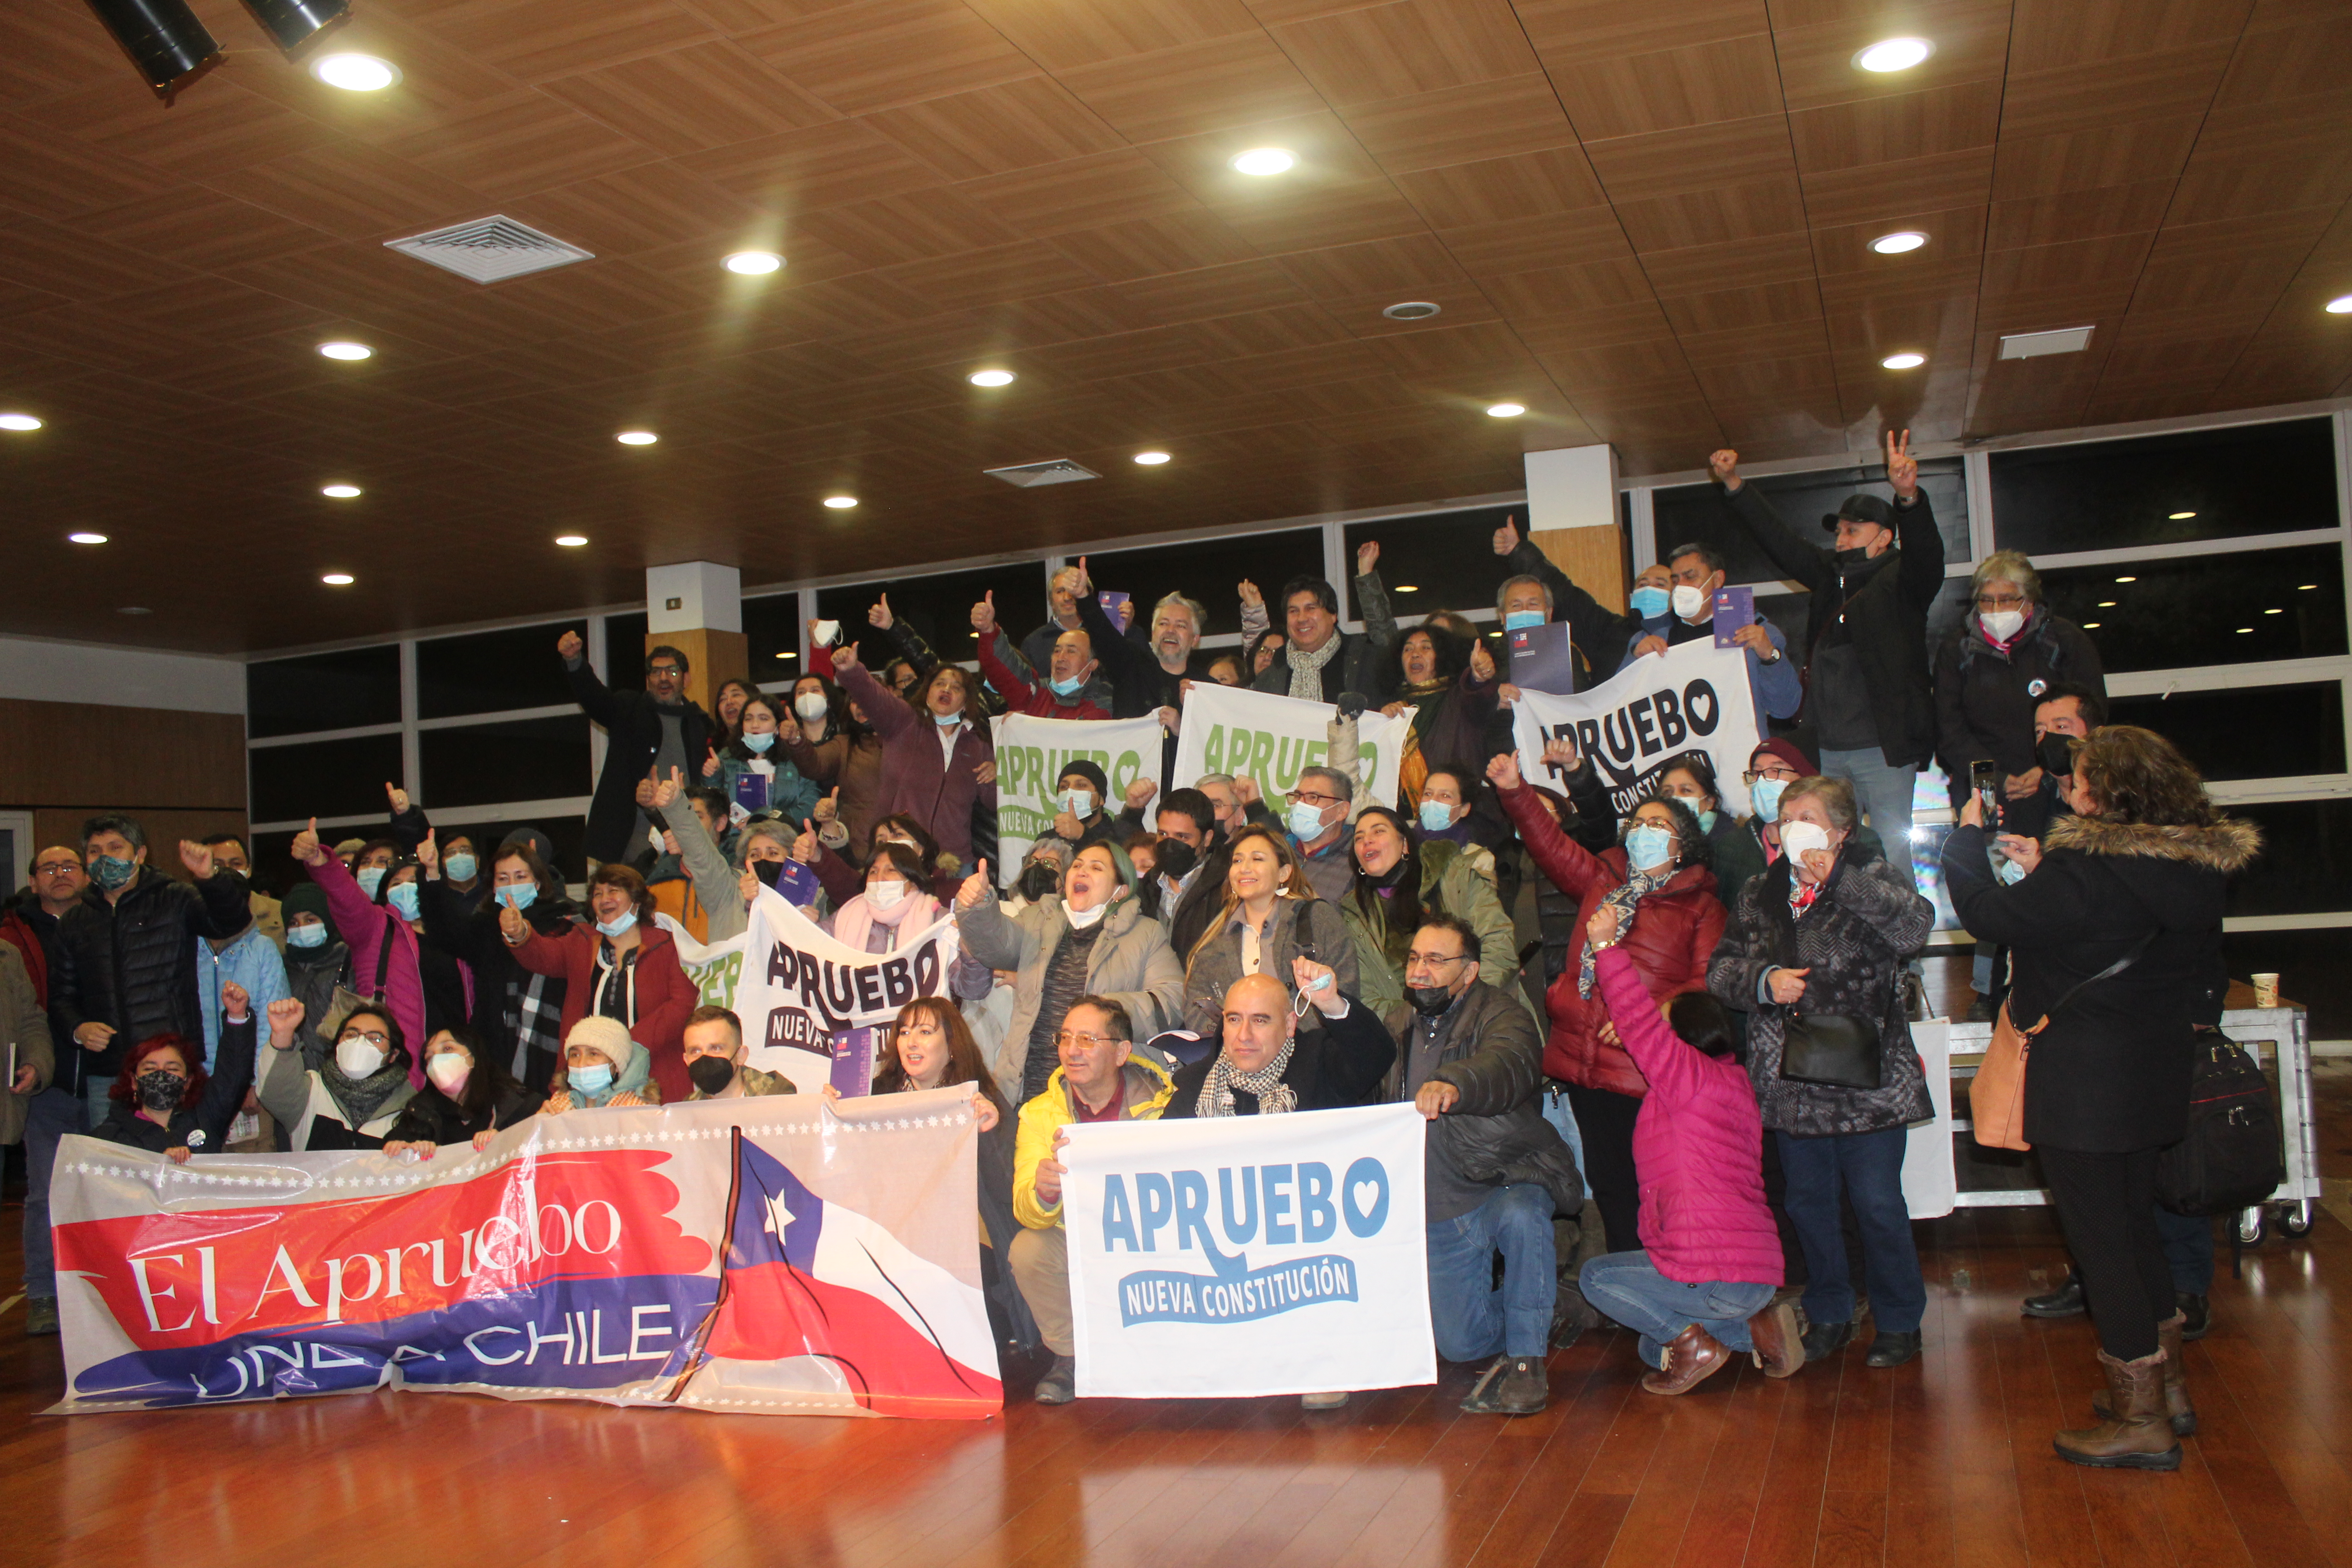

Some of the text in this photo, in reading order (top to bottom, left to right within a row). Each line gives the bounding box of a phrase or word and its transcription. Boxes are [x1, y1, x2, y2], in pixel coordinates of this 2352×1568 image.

[996, 746, 1140, 802] APRUO
[1205, 724, 1377, 794] APRUEO
[1000, 811, 1034, 835] NUEVA
[767, 939, 940, 1014] APRUEBO
[772, 1015, 823, 1048] NUEVA
[1102, 1156, 1390, 1259] APRUEBO
[128, 1180, 621, 1333] El Apruebo
[1127, 1258, 1350, 1317] NUEVA CONSTITUCIÓN
[463, 1304, 672, 1366] CHILE
